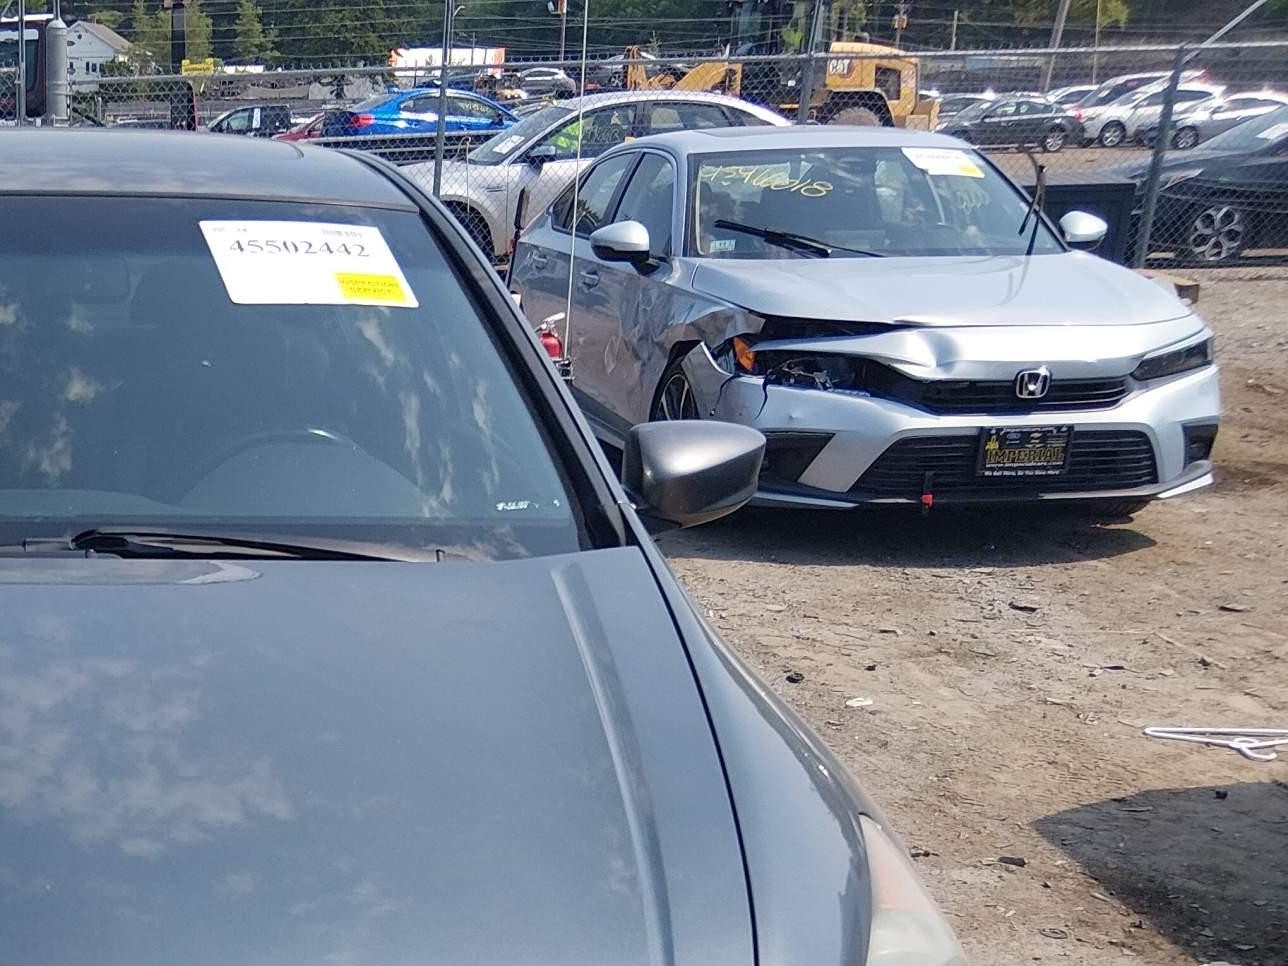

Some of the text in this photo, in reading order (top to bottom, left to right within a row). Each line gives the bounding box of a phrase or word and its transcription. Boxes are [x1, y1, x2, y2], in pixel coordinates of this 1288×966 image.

[829, 58, 851, 75] CAT
[229, 239, 371, 257] 45502442
[986, 447, 1065, 463] IMPERIAL
